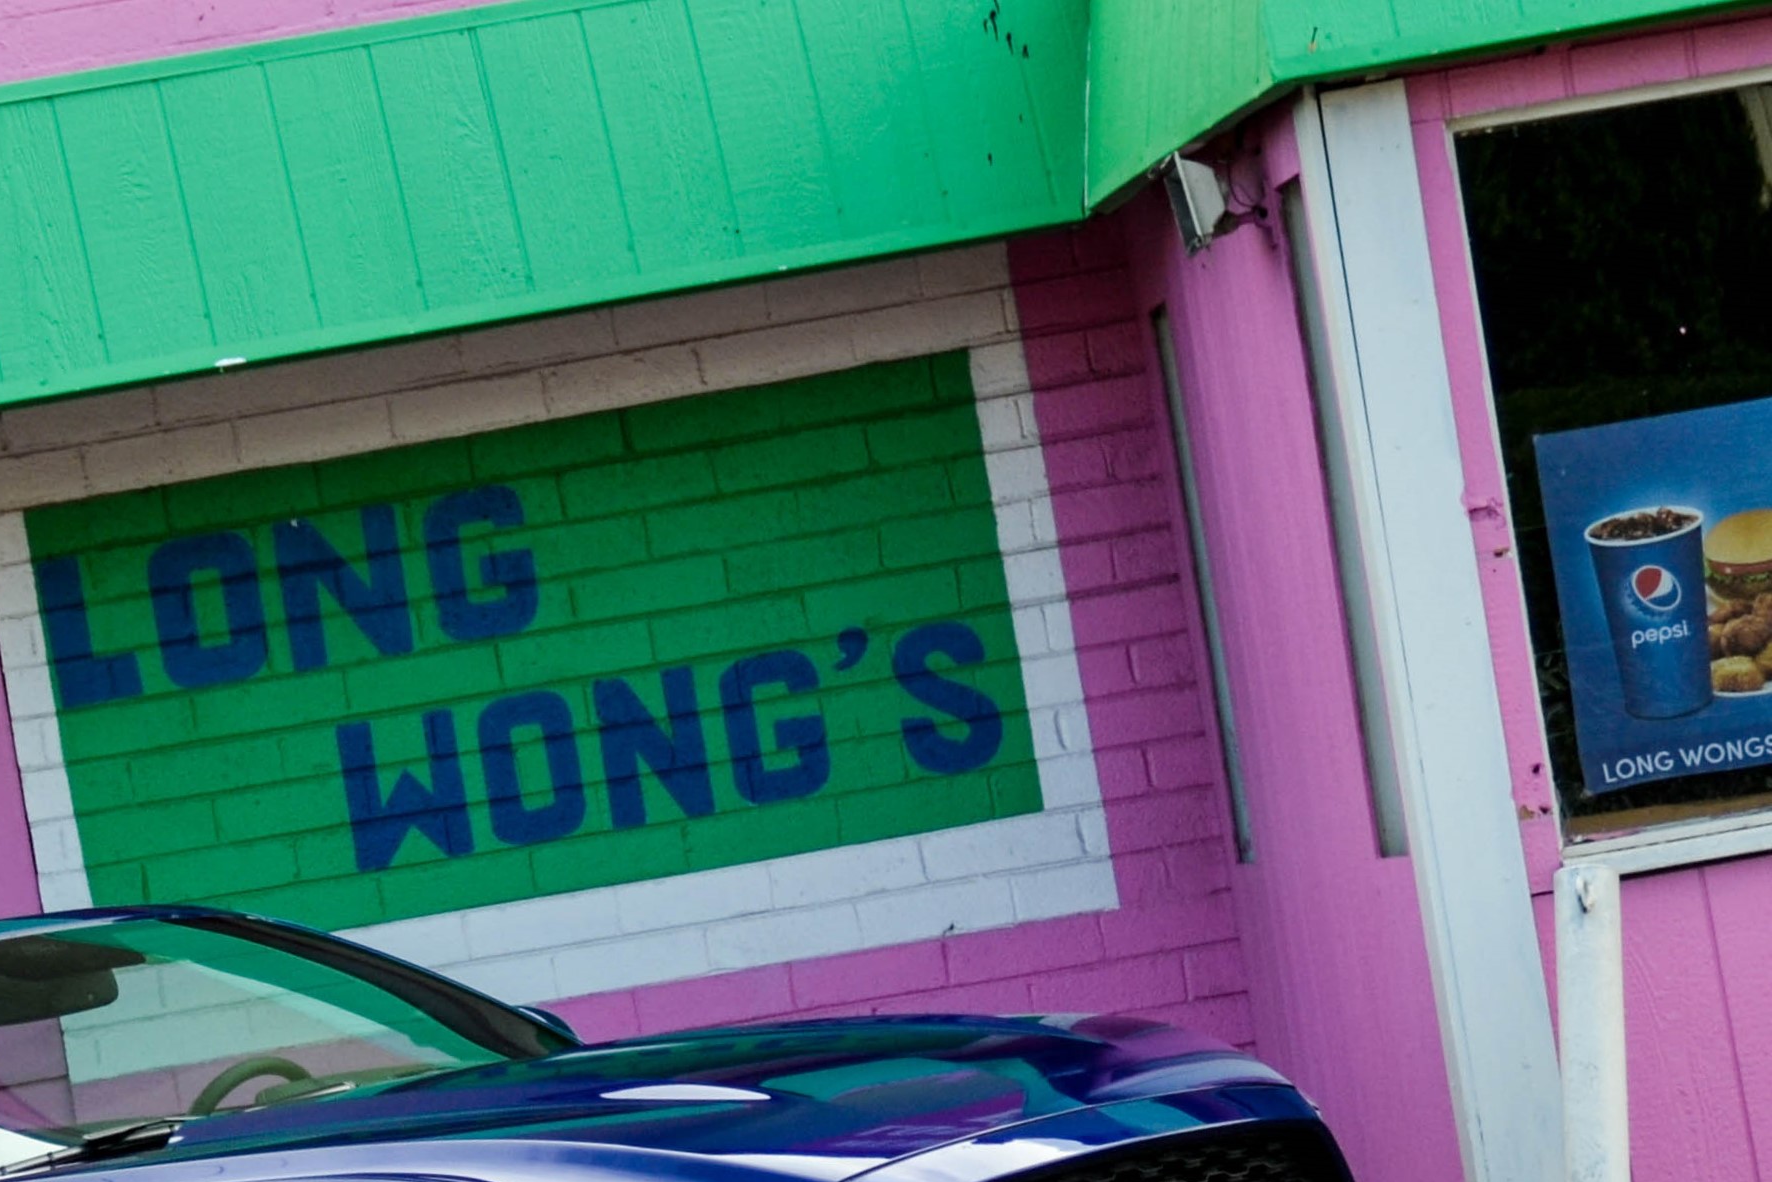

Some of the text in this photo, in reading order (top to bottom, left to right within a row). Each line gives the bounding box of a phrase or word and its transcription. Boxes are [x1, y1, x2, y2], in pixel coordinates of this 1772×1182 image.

[33, 484, 540, 708] LONG
[1631, 619, 1689, 649] pepsi
[335, 620, 1003, 874] WONG'S
[1602, 751, 1674, 784] LONG
